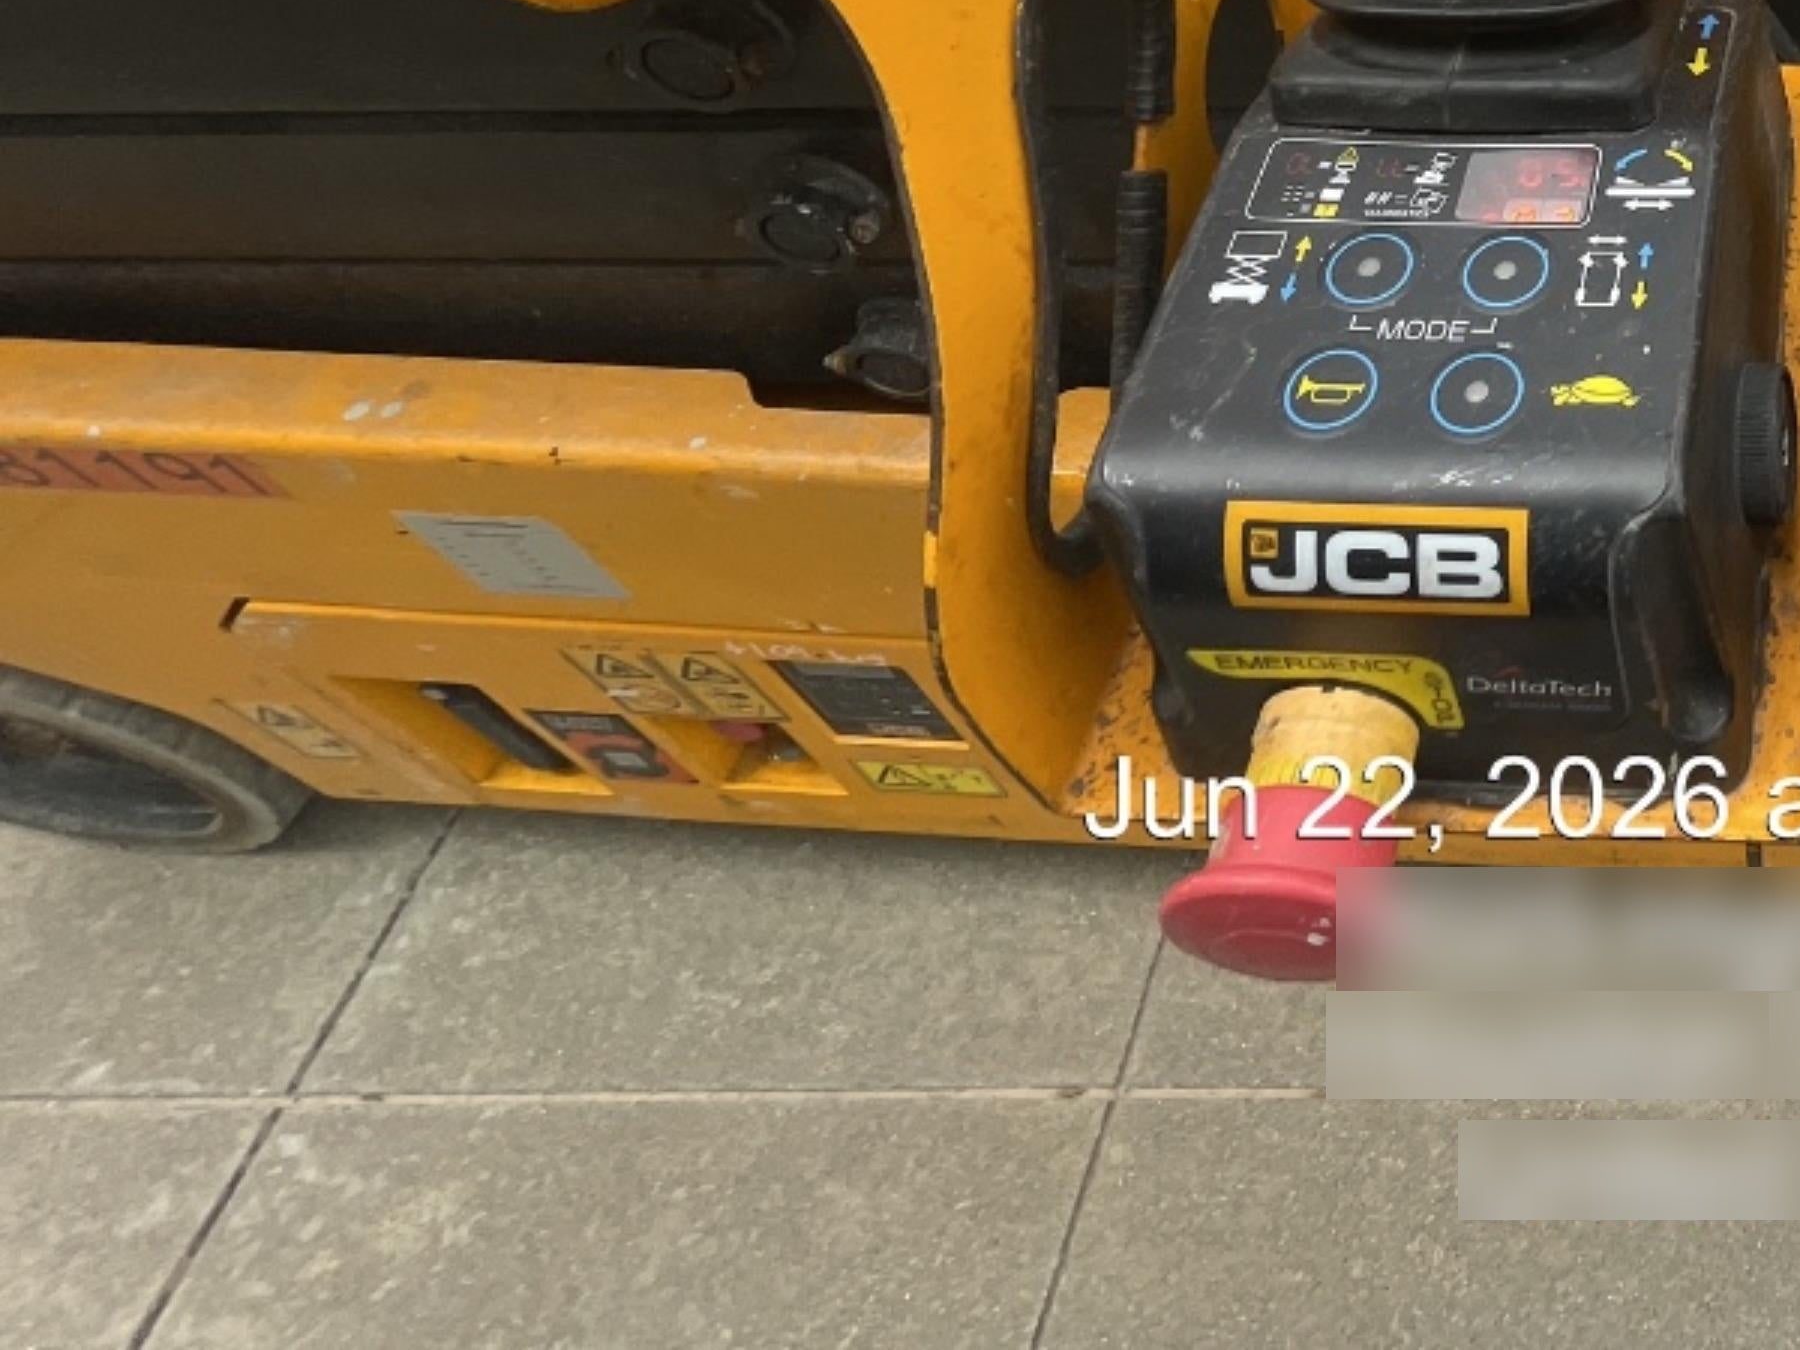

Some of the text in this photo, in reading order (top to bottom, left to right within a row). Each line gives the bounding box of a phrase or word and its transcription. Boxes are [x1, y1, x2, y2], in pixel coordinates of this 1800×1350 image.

[1376, 317, 1471, 343] MODE
[1250, 529, 1504, 599] JCB
[1214, 654, 1414, 676] EMERGENCY
[1466, 674, 1613, 698] DeltaTech
